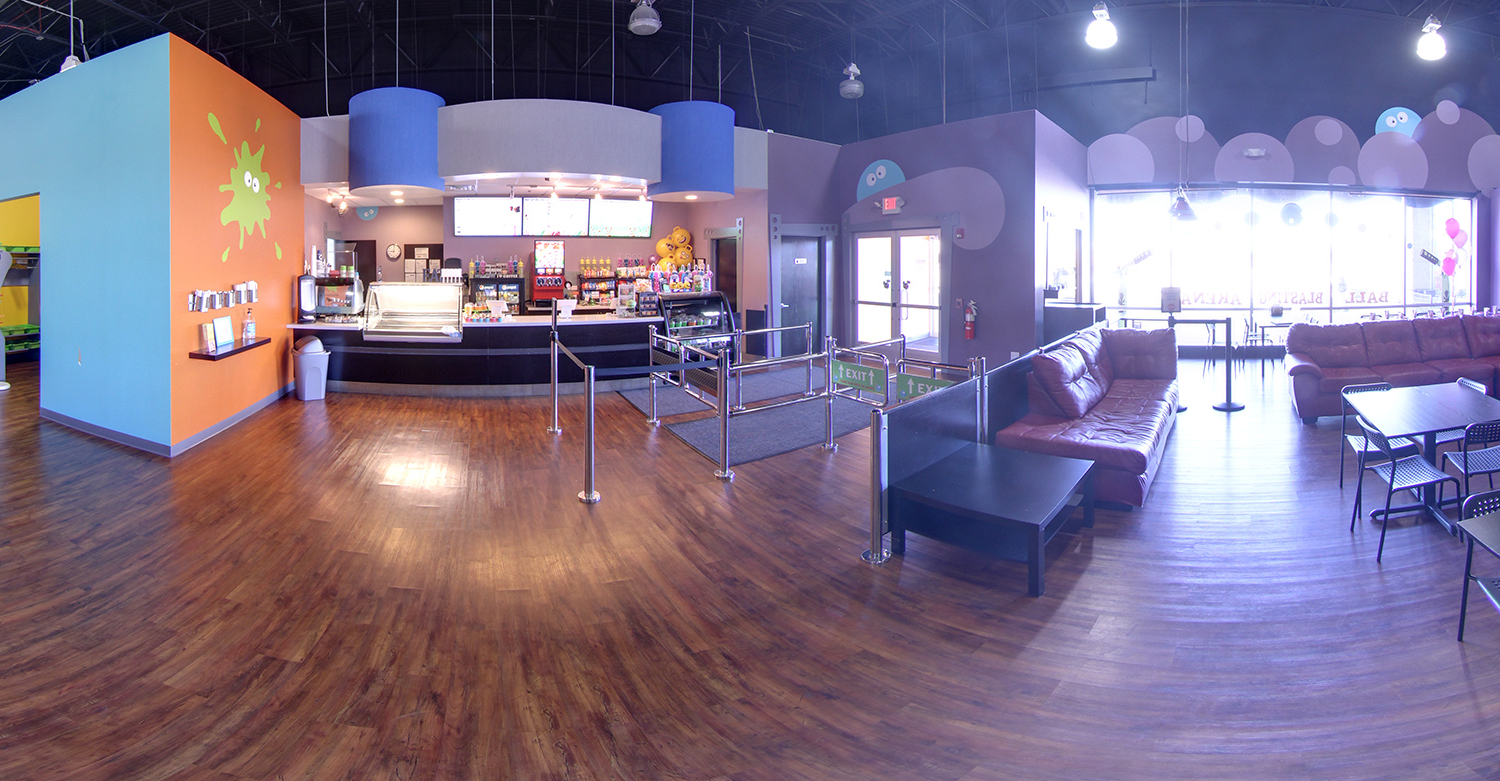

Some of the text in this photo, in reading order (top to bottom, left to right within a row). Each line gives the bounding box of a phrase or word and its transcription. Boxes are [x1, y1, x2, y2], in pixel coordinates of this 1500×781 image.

[884, 197, 896, 210] EXIT
[846, 368, 867, 382] EXIT
[917, 383, 941, 394] EX
